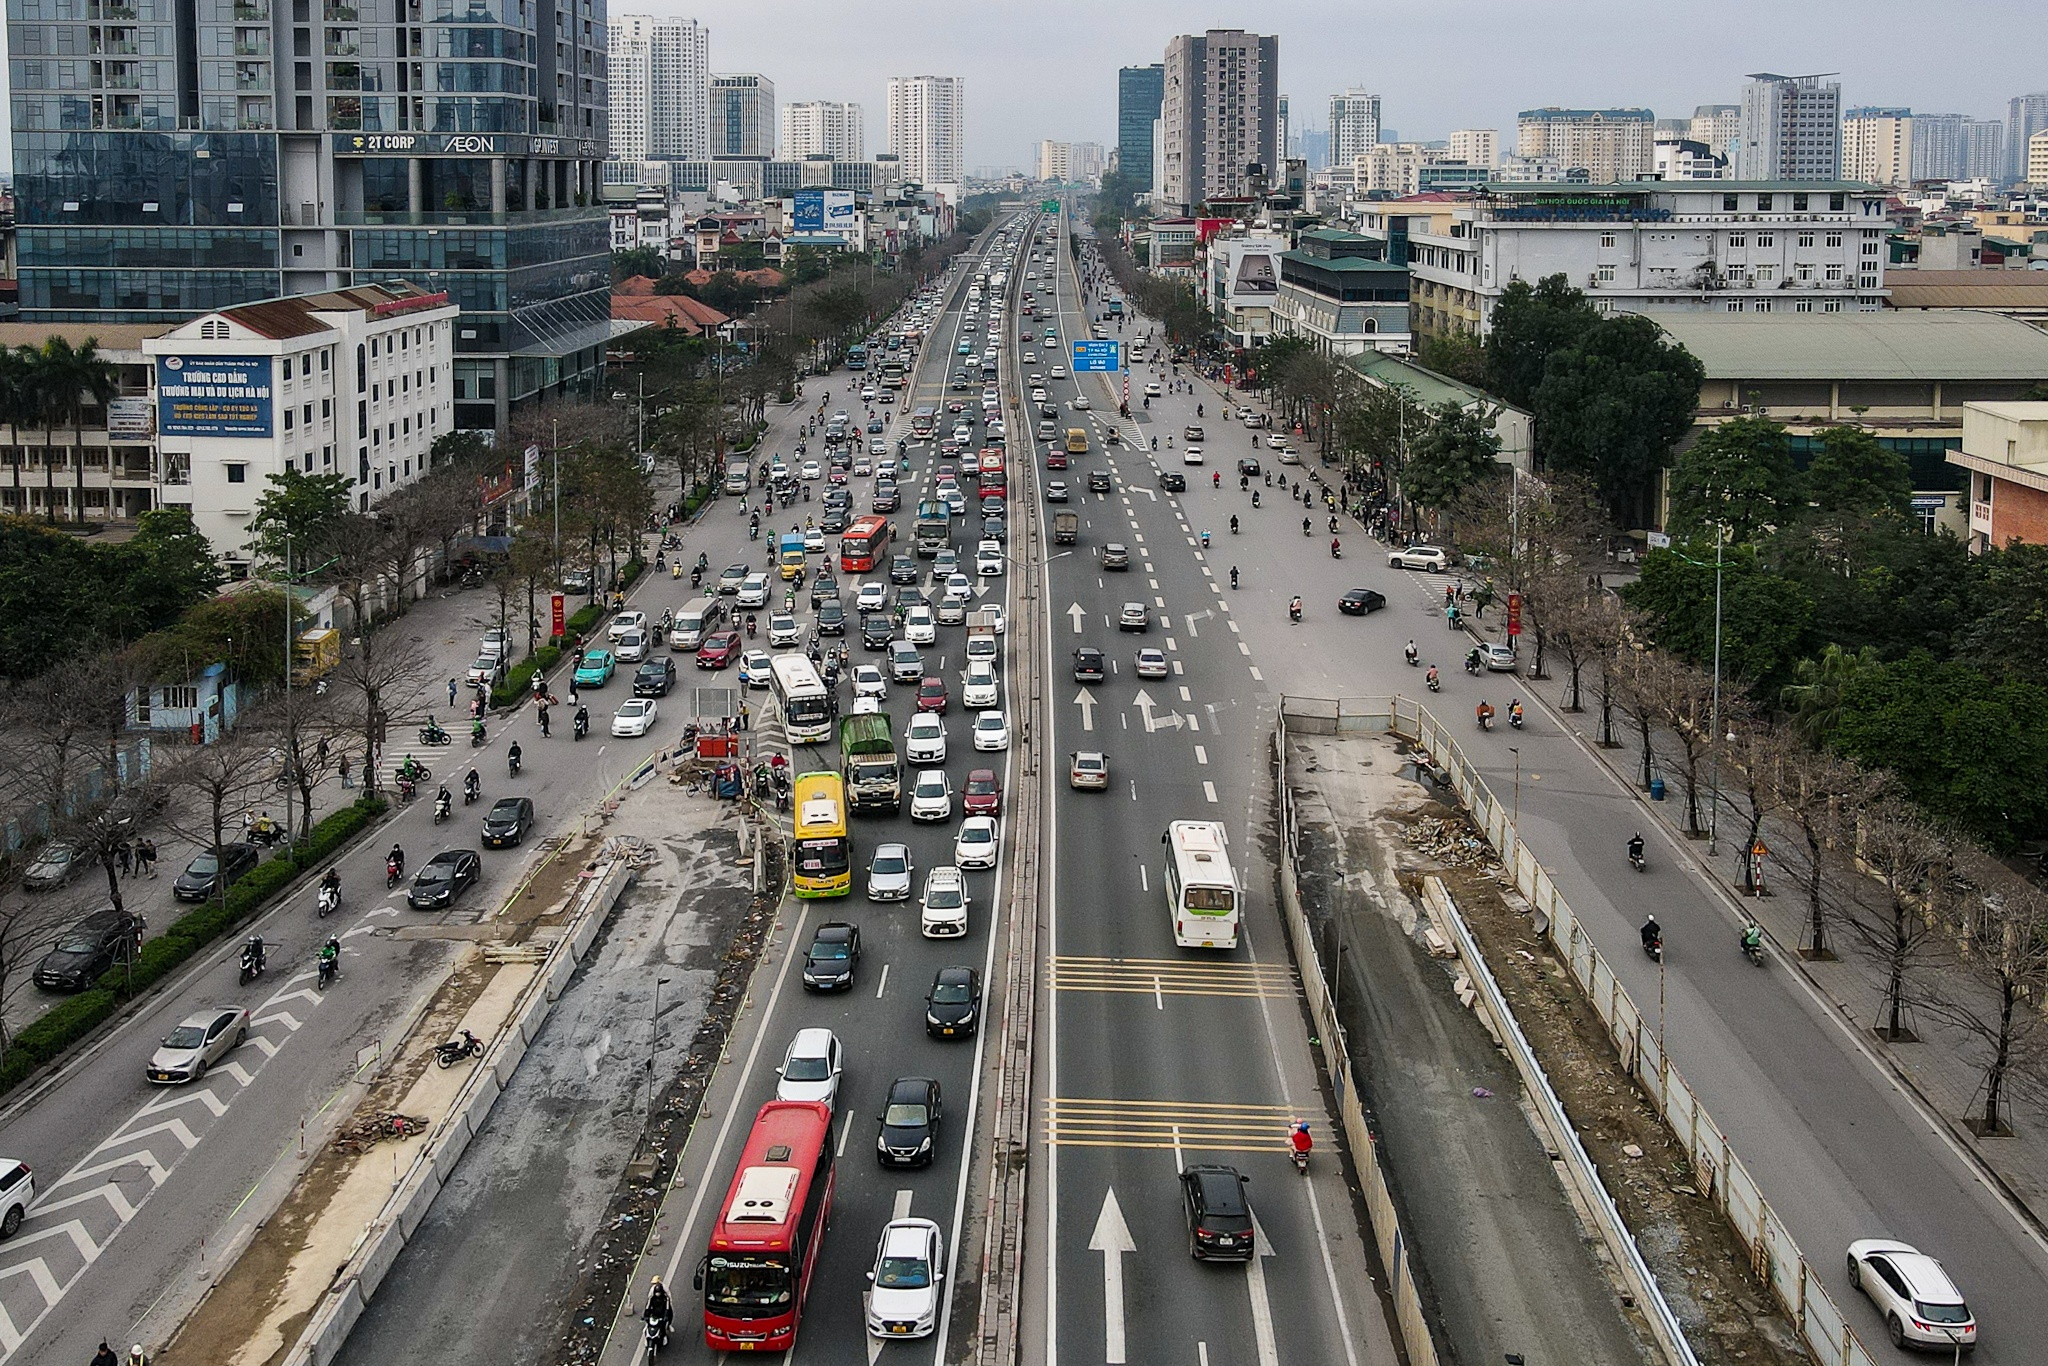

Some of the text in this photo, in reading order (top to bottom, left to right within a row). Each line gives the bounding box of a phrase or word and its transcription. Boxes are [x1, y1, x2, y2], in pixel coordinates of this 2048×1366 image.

[368, 135, 415, 149] 2T CORP
[1862, 201, 1881, 216] Y1
[182, 368, 248, 384] TRƯỜNG CAO ĐẲNG
[161, 384, 270, 400] THƯƠNG MẠI VÀ DU LỊCH HÀ NỘI
